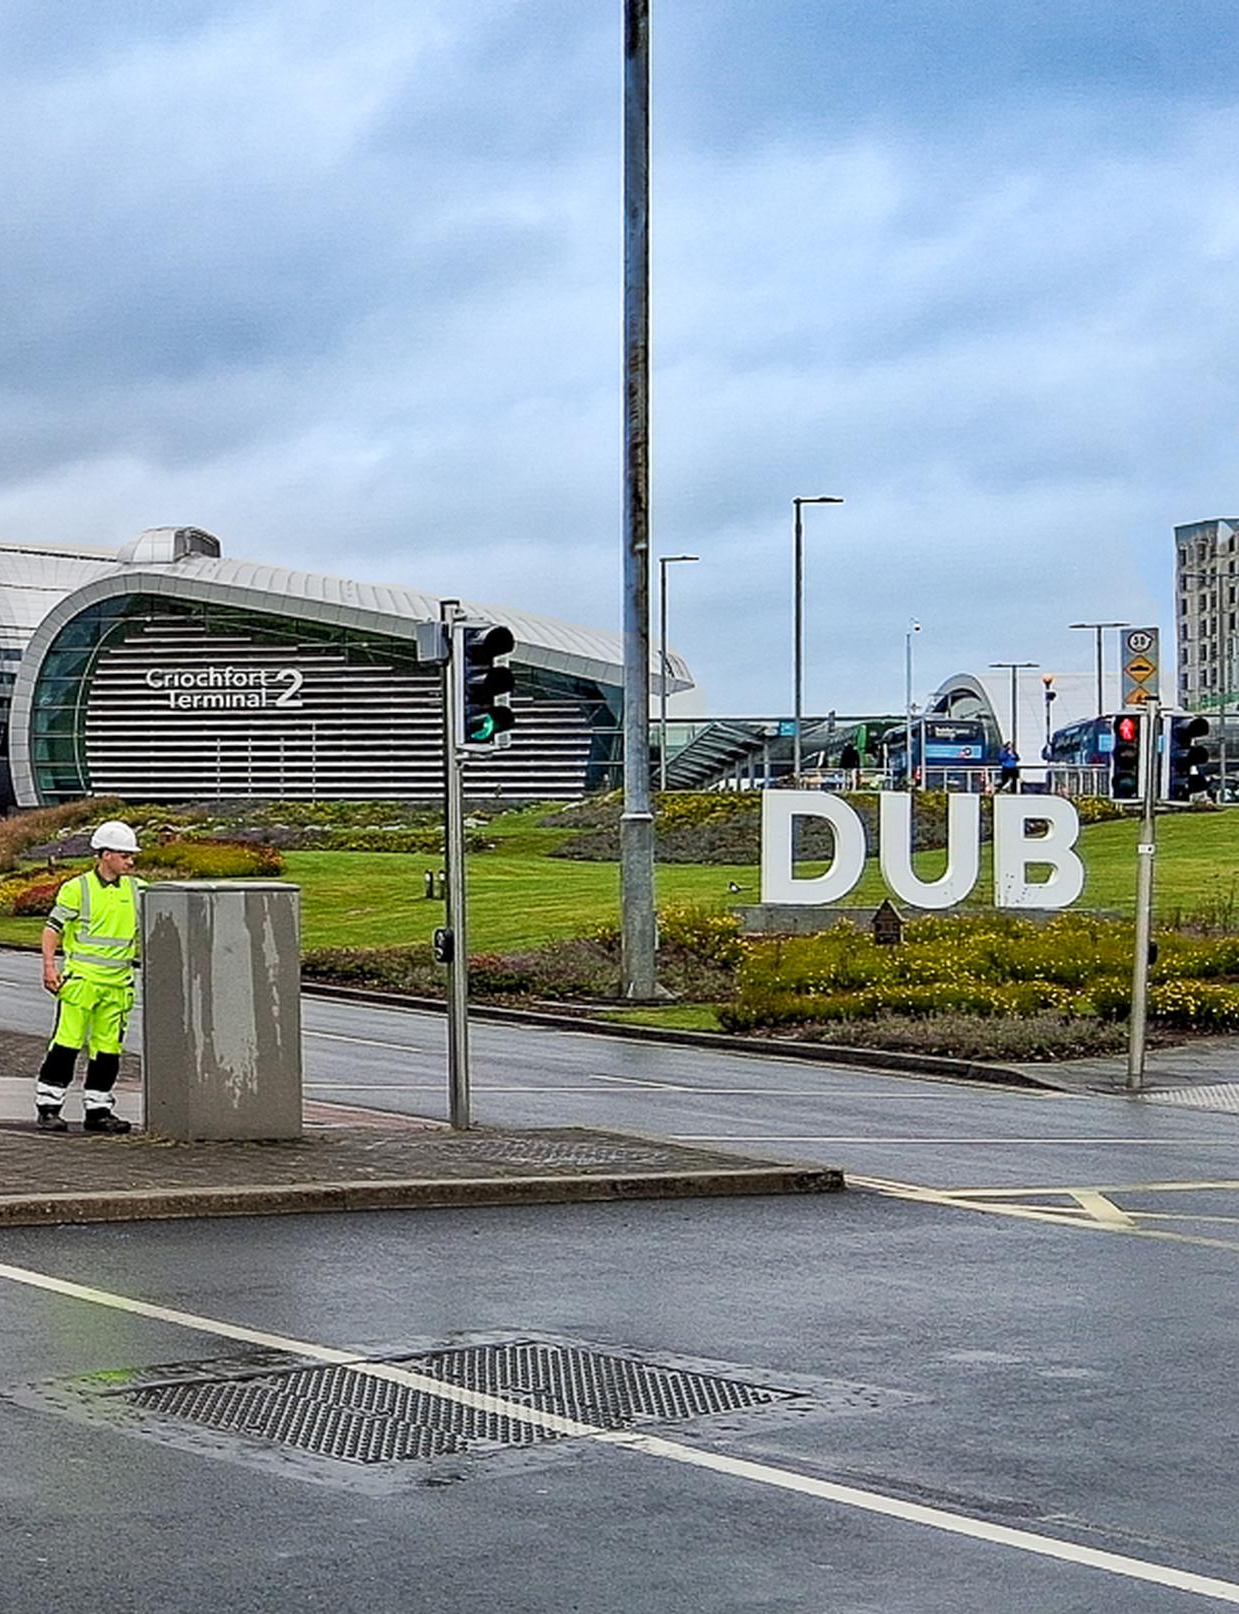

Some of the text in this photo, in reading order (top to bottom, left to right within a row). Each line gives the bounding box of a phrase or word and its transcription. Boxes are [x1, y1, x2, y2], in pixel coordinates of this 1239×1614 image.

[167, 687, 267, 709] Terminal
[275, 668, 304, 708] 2
[761, 789, 1085, 910] DUB
